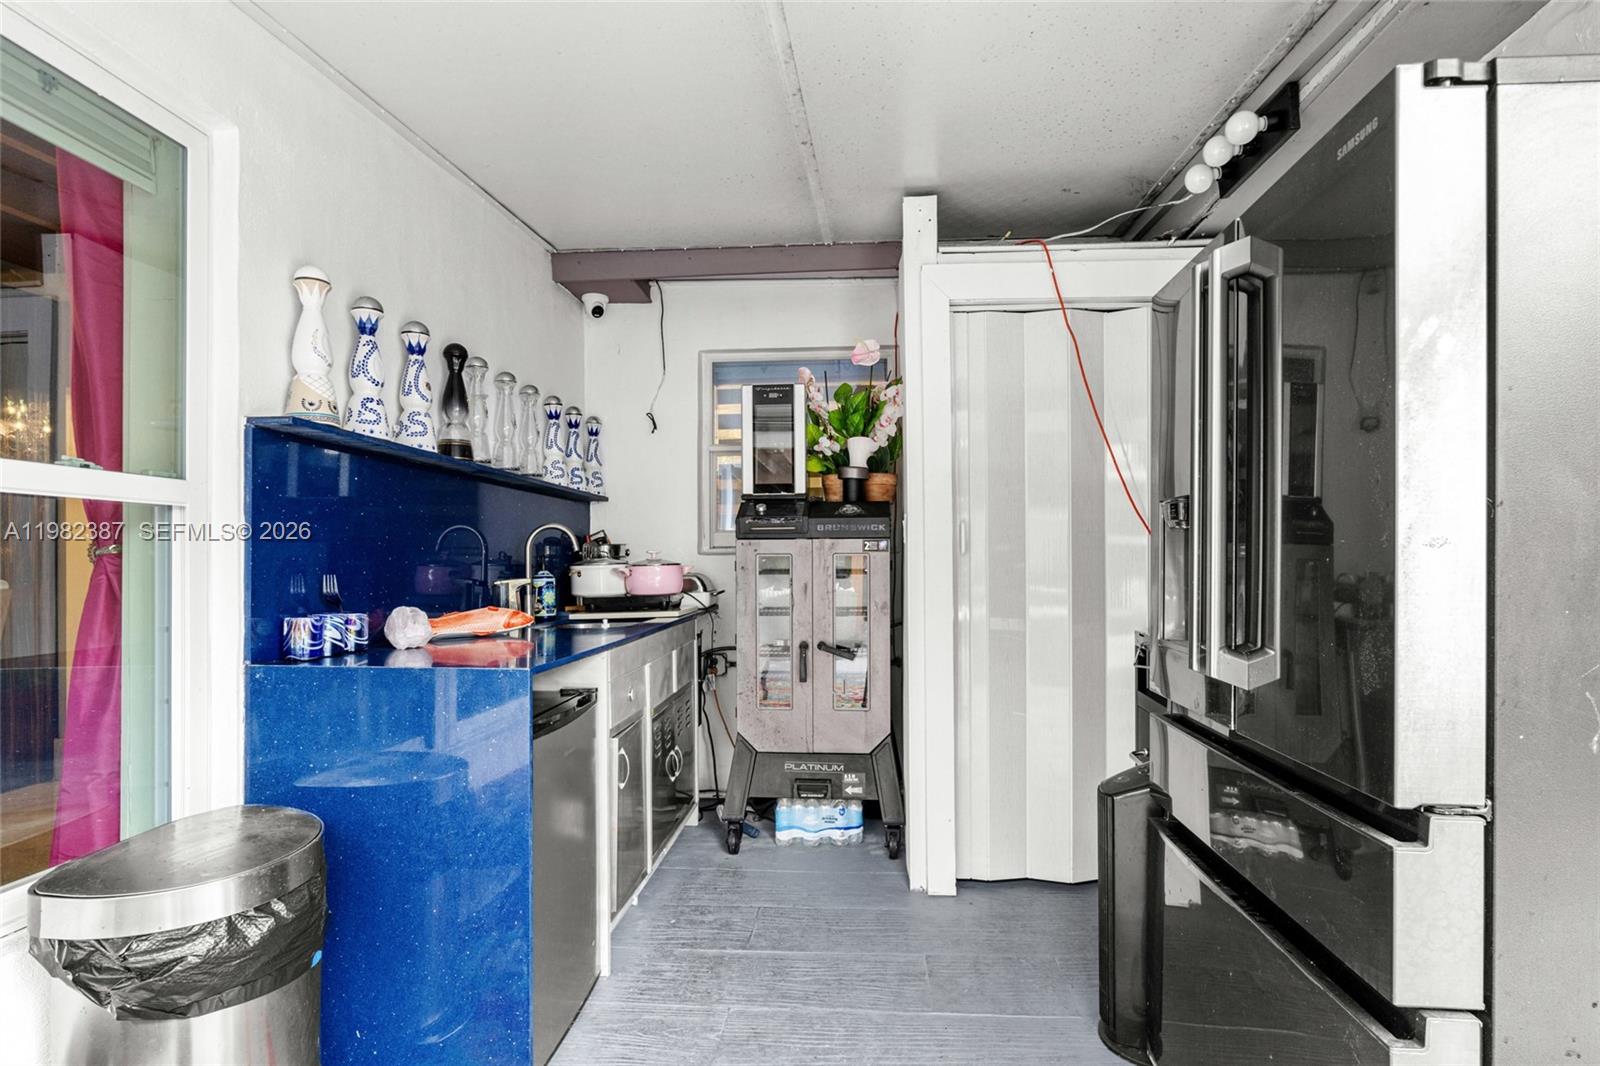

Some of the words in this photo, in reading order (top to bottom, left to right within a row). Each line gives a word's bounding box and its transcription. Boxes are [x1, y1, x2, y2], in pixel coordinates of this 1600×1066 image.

[1337, 116, 1378, 161] SAMSUNG
[816, 523, 886, 532] BRUNSWICK
[784, 763, 845, 772] PLATINUM
